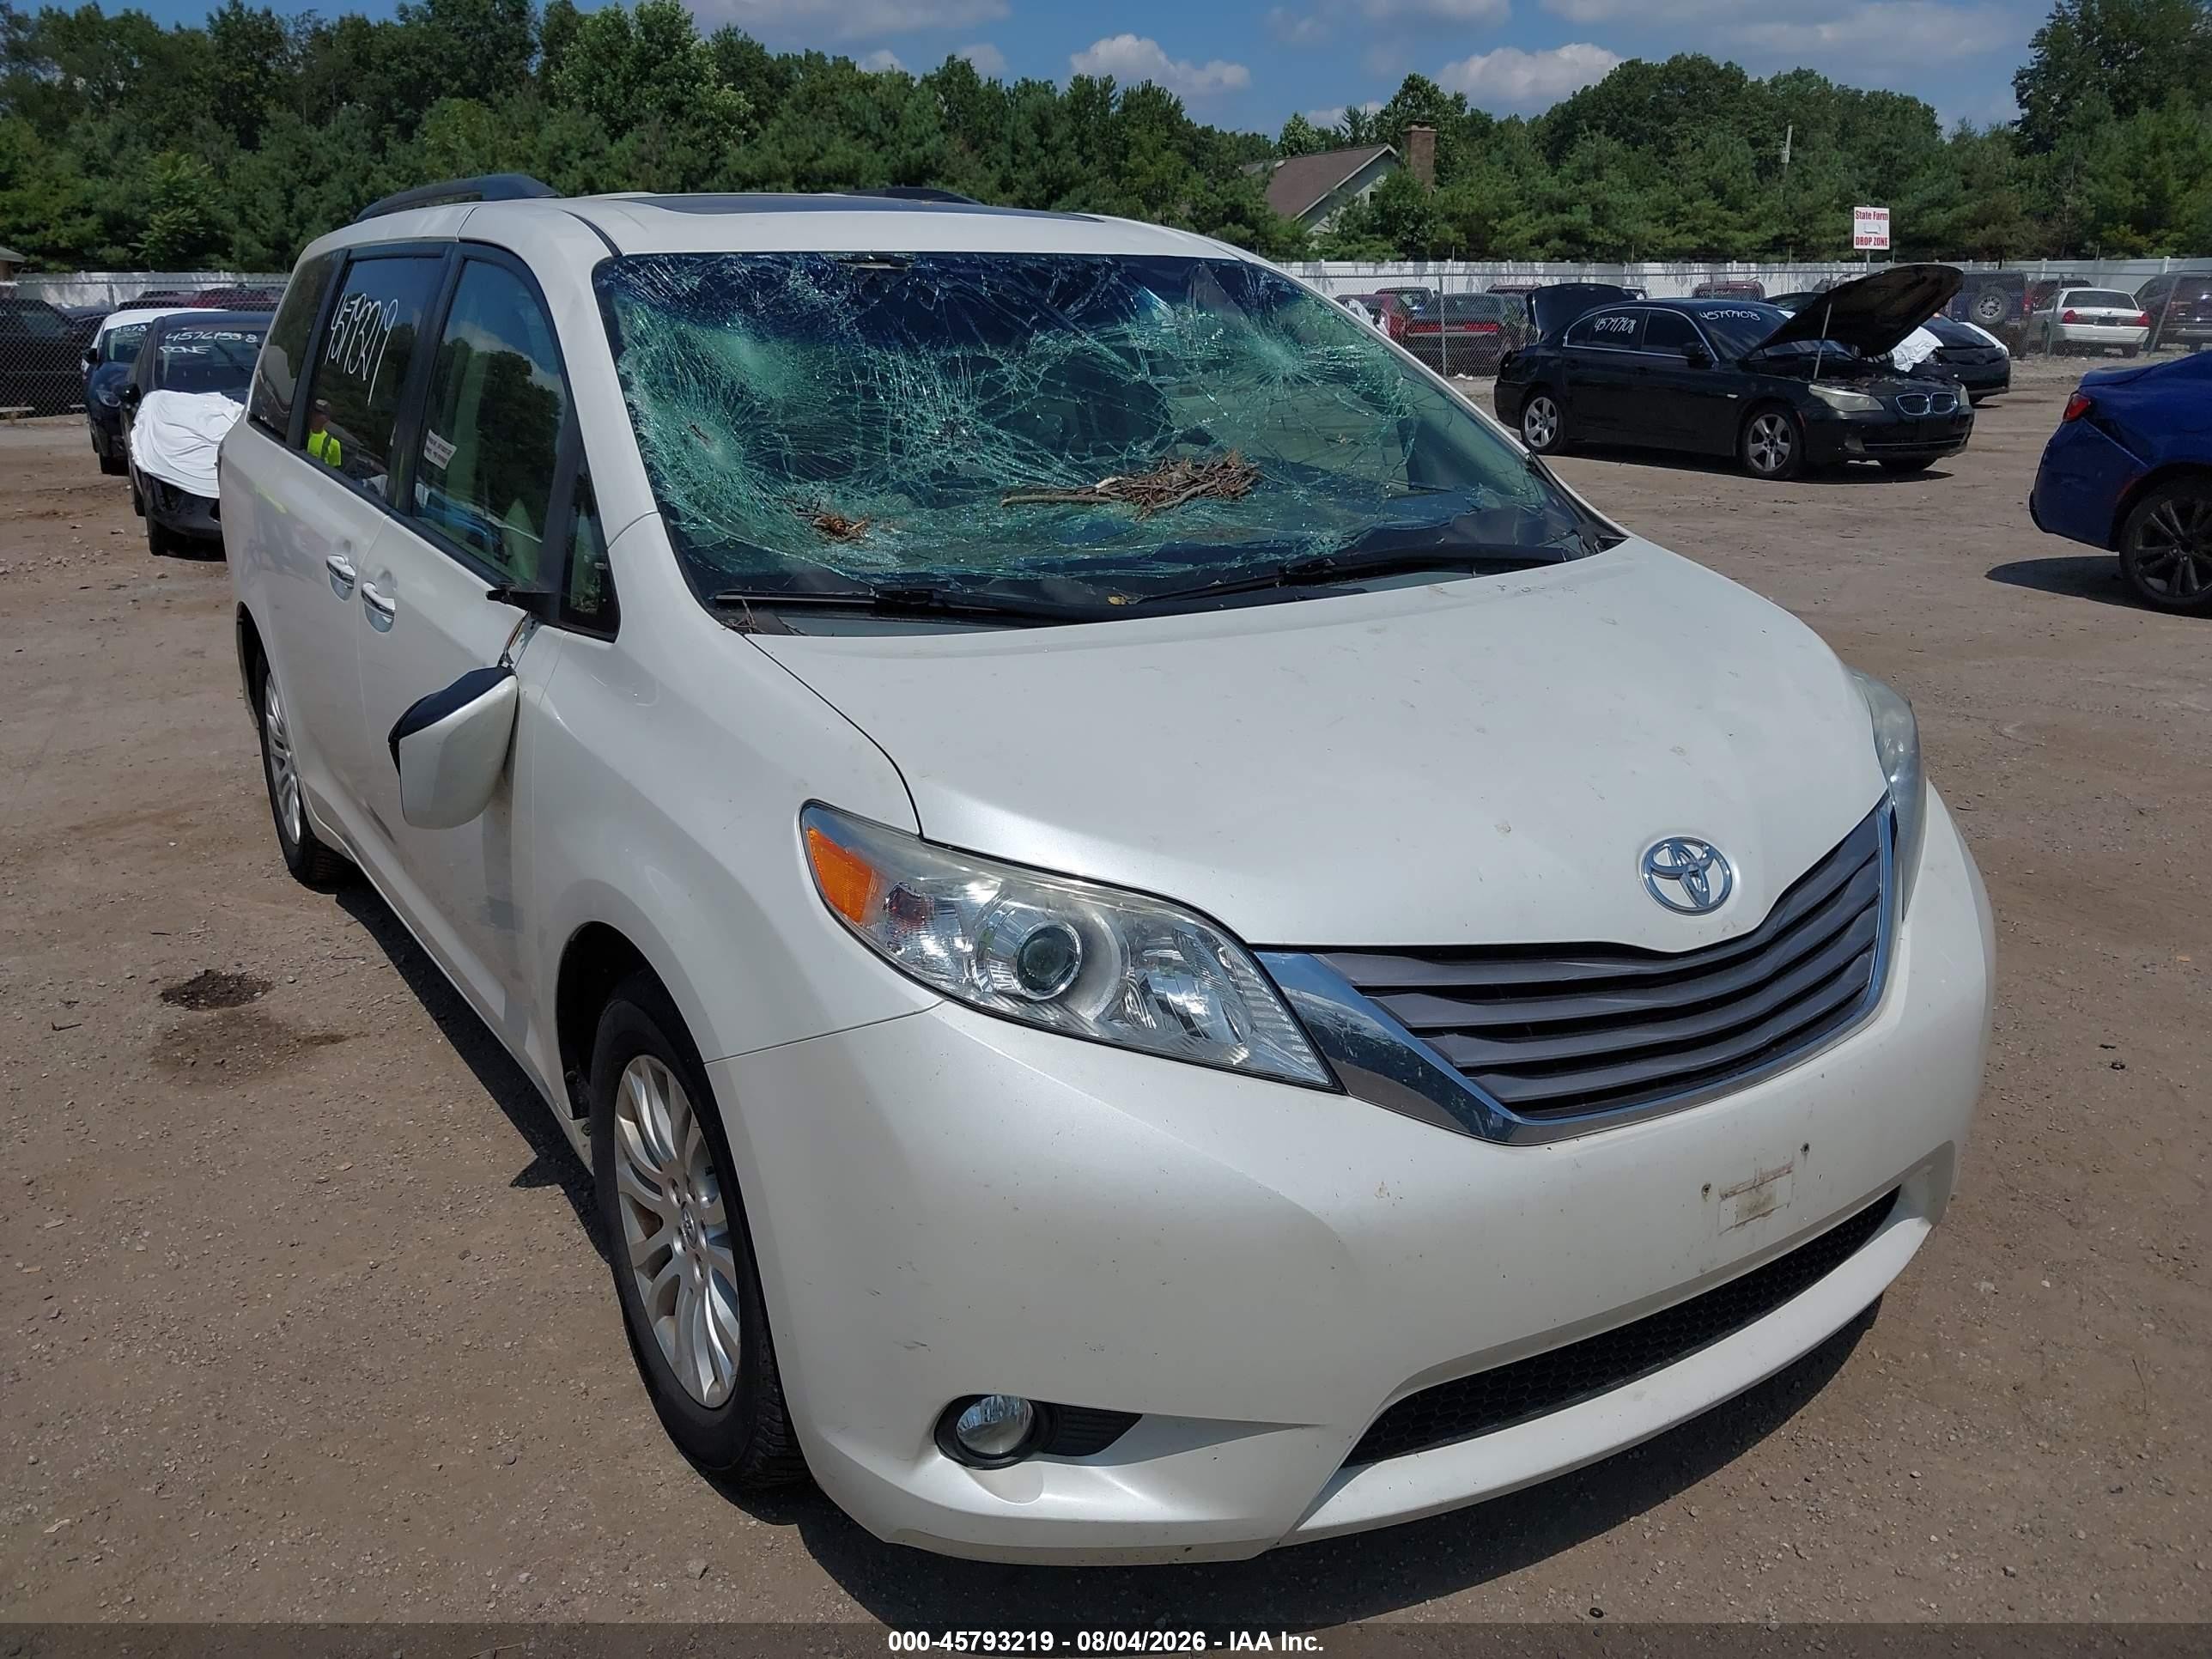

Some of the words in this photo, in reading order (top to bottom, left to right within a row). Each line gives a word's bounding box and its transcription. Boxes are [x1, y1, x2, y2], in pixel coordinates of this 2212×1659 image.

[1855, 210, 1872, 220] State
[1873, 211, 1888, 221] Farm
[1856, 236, 1873, 246] DROP
[1873, 237, 1888, 246] ZONE
